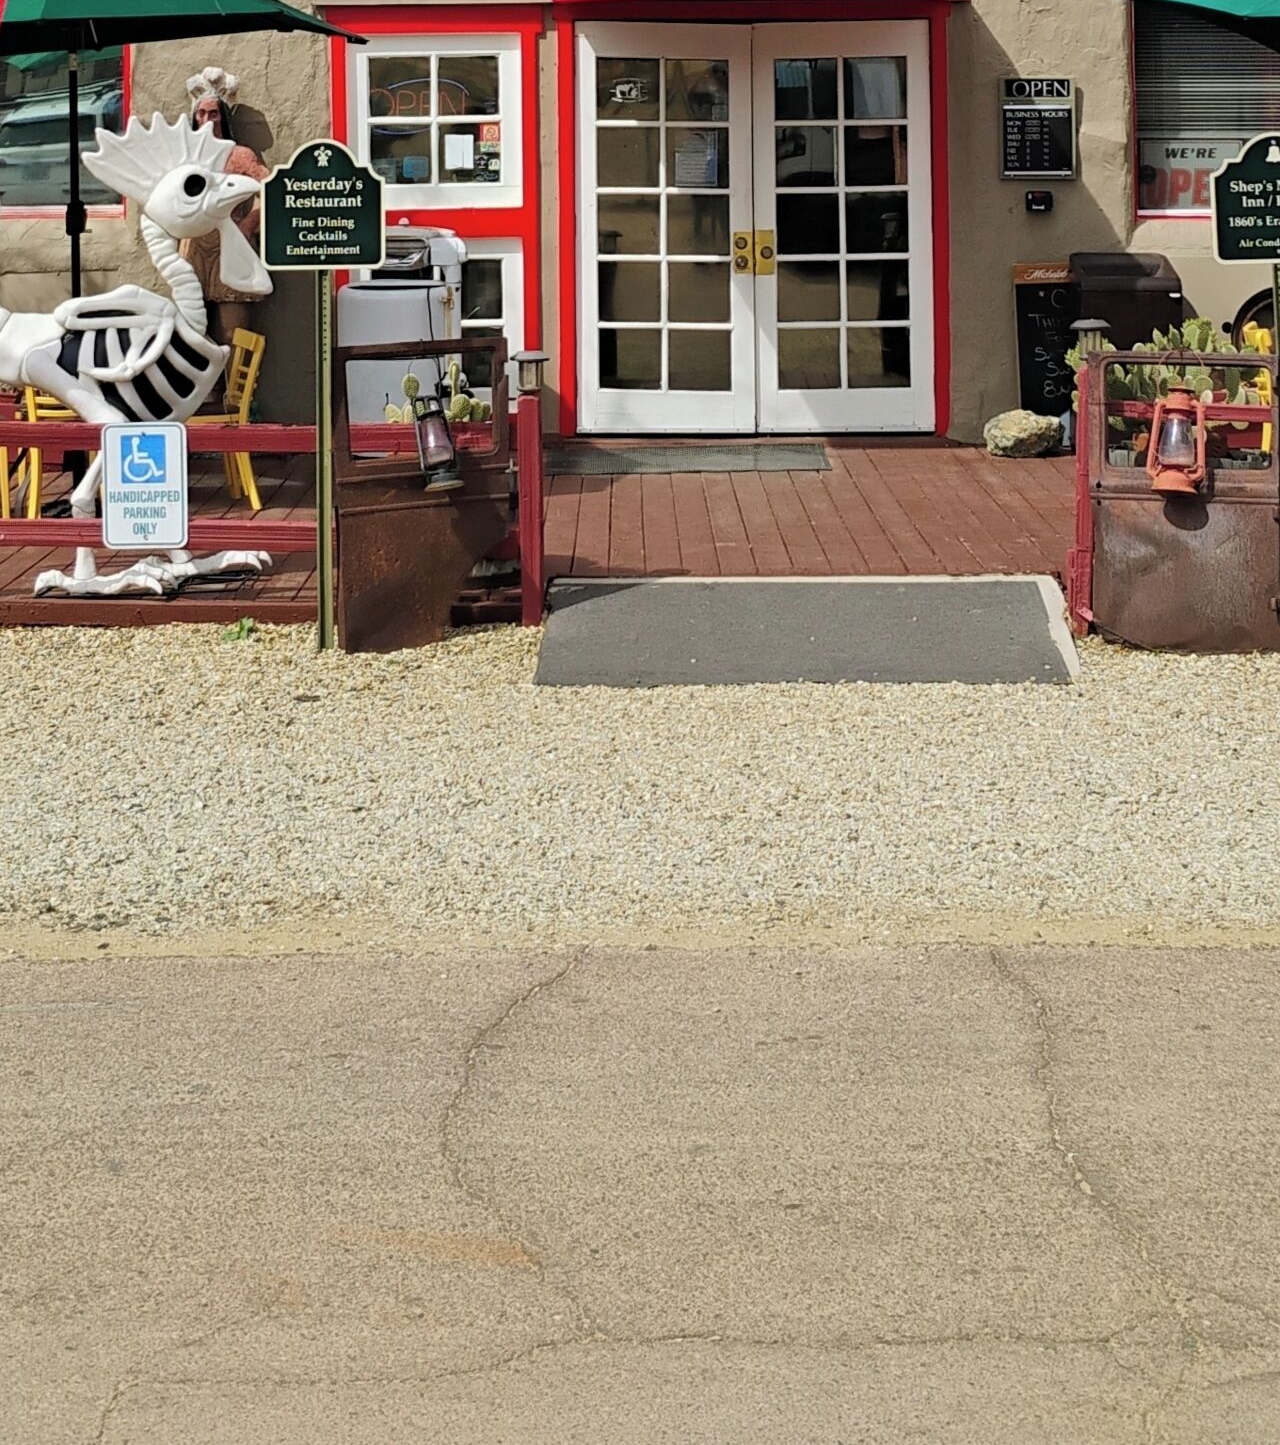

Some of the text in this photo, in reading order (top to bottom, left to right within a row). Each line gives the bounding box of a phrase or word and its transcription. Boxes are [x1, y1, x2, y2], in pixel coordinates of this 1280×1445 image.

[1012, 80, 1069, 98] OPEN
[369, 88, 465, 116] OPEN
[1005, 110, 1069, 119] BUSINESS HOURS
[1164, 147, 1218, 159] WE'RE
[283, 176, 363, 194] Yesterday's
[1144, 167, 1215, 207] OPE
[1229, 179, 1274, 195] Shep's
[285, 195, 362, 208] Restaurant
[1241, 195, 1265, 207] Inn
[1267, 194, 1273, 207] /
[292, 216, 355, 229] Fine Dining
[1228, 216, 1263, 227] 1860's
[298, 230, 348, 241] Cocktails
[286, 244, 361, 255] Entertainment
[1238, 239, 1255, 248] Air
[109, 490, 181, 504] HANDICAPPED
[123, 506, 167, 519] PARKING
[132, 522, 158, 536] ONLY
